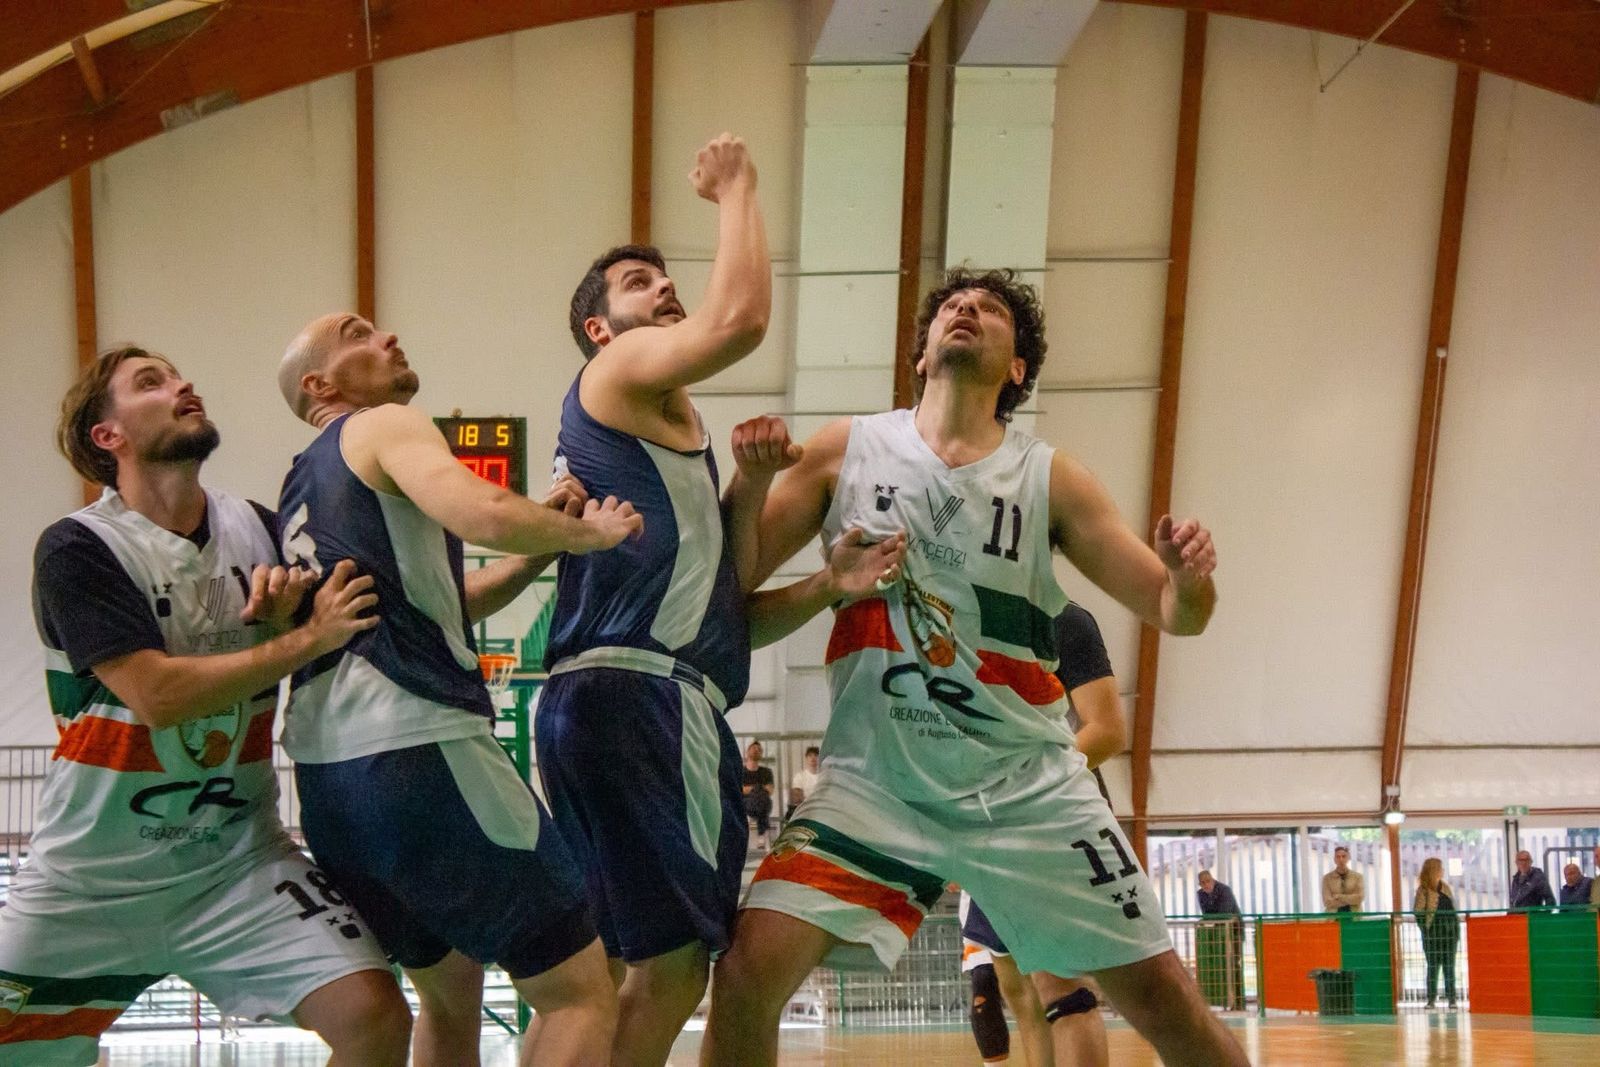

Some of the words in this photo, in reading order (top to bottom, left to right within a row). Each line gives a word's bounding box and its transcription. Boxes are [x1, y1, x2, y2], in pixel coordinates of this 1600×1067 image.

[458, 425, 479, 446] 18
[496, 425, 509, 446] 5
[906, 533, 967, 565] VNCENZI
[982, 496, 1022, 562] 11
[889, 705, 943, 725] CREAZIONE
[1070, 827, 1139, 887] 11
[273, 870, 347, 921] 18
